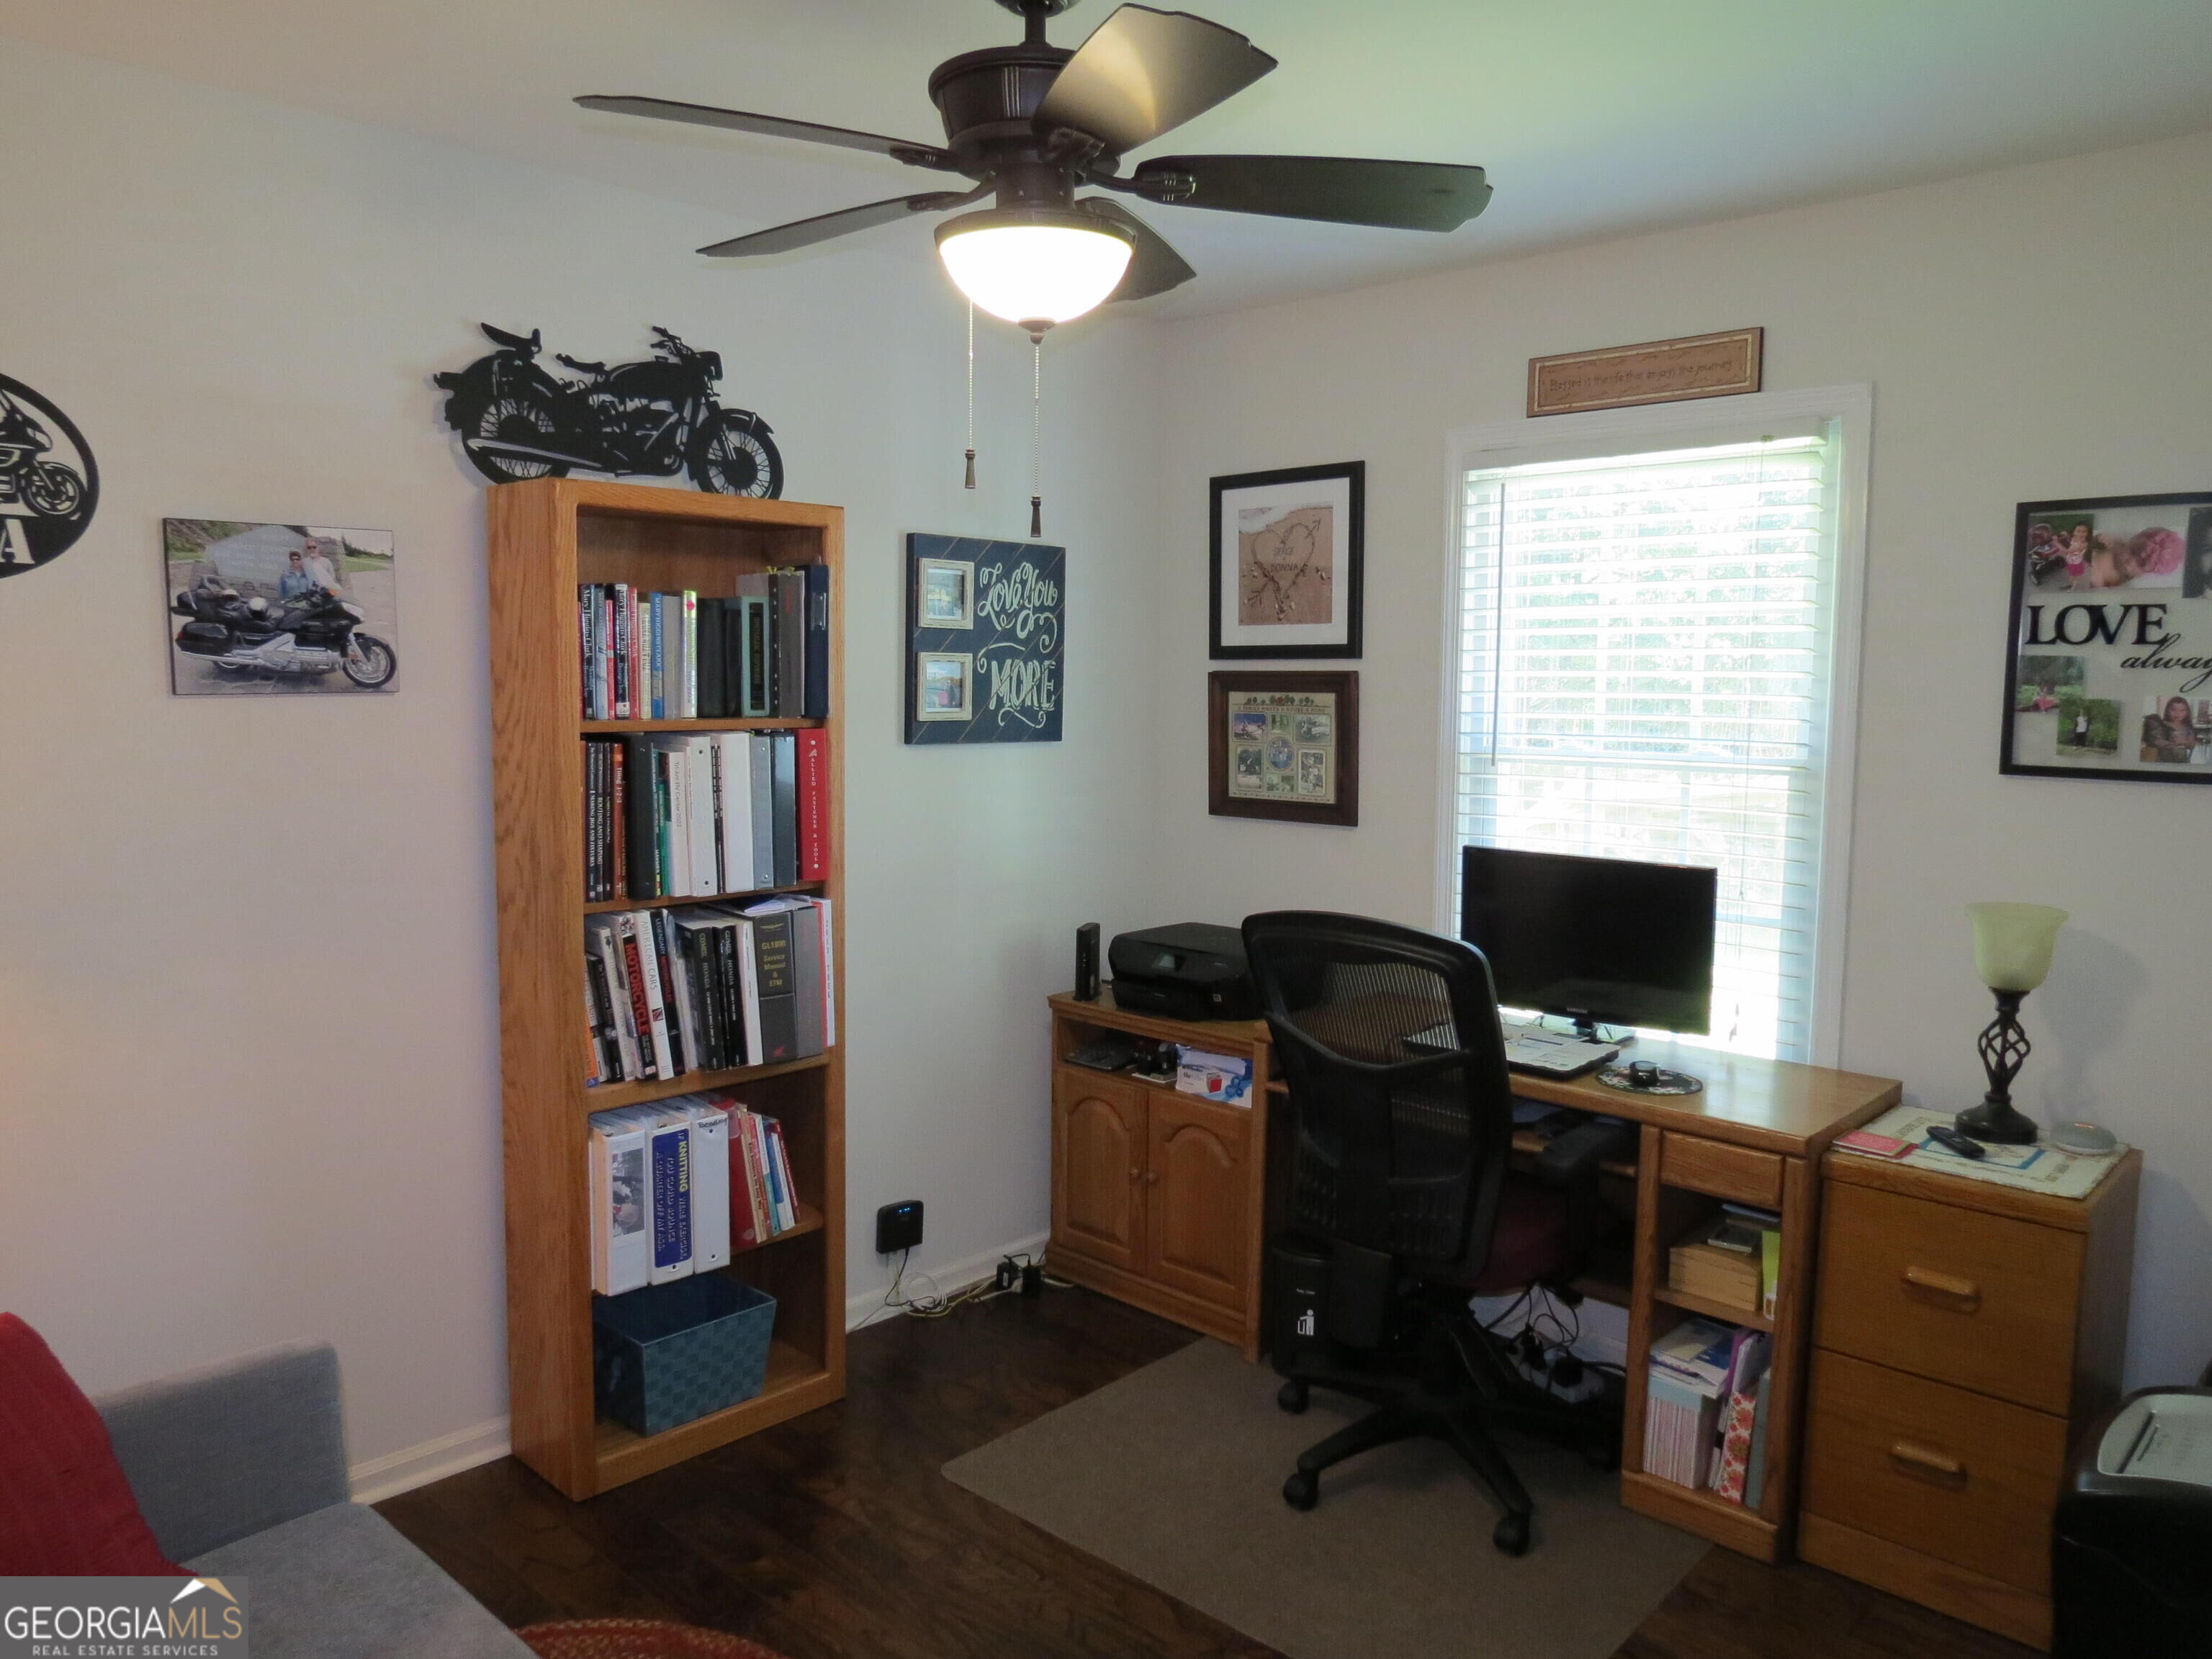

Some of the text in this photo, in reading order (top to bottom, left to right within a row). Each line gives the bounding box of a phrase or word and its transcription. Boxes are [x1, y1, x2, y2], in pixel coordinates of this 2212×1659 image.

[1270, 564, 1299, 572] DONNA
[618, 608, 627, 636] Higgins
[2025, 603, 2168, 645] LOVE
[585, 639, 593, 658] Clark
[989, 659, 1056, 711] MORE
[640, 920, 657, 991] AMERICAN CARS
[656, 918, 673, 1003] LEGENDARY MOTORCYCLES
[764, 962, 786, 971] Manual
[625, 943, 651, 1035] MOTORCYCLE
[702, 962, 711, 989] HONDA
[698, 1117, 727, 1128] Beading
[678, 1141, 688, 1193] KNITTING
[667, 1177, 675, 1205] COULD
[656, 1200, 665, 1216] OFF
[657, 1218, 665, 1231] MY
[667, 1208, 676, 1243] BOUNCE
